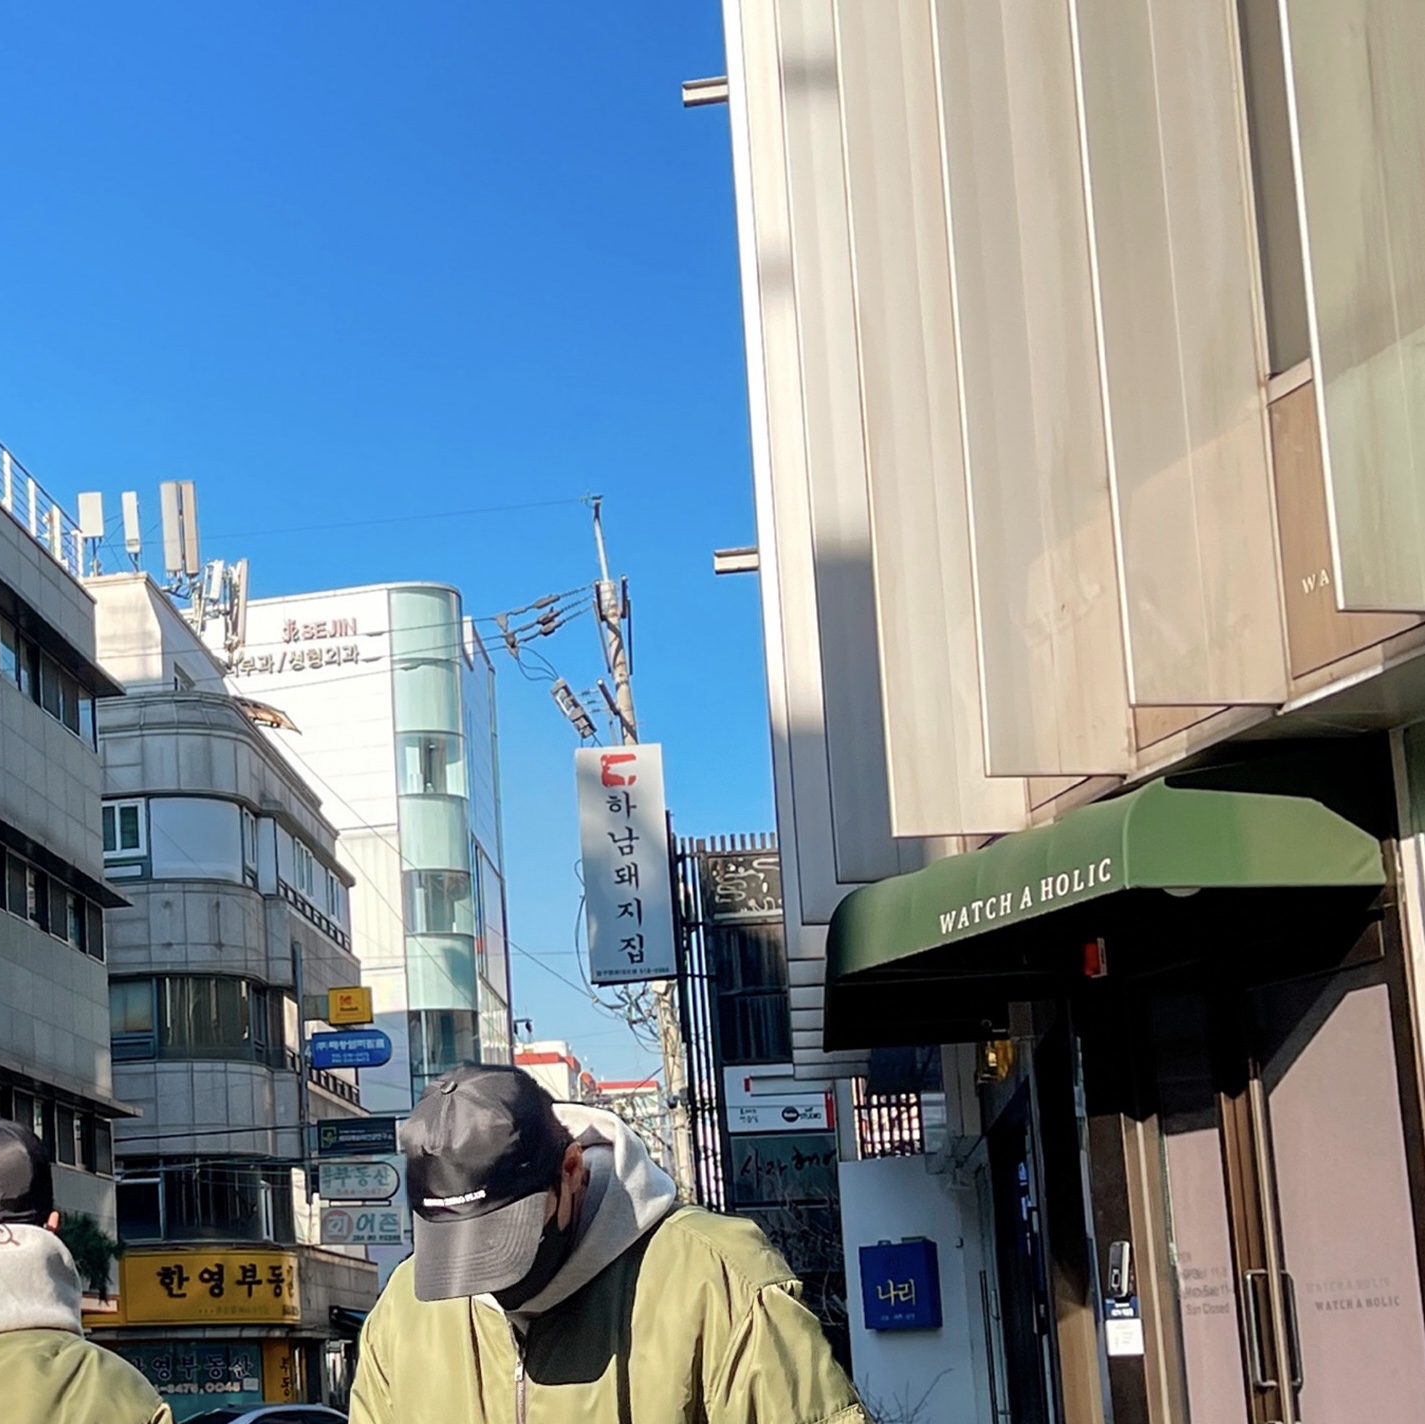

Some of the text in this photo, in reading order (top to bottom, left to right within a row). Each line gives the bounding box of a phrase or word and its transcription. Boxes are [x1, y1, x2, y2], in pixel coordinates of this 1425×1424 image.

[606, 791, 644, 964] 하남돼지집
[939, 858, 1112, 935] WATCH A HOLIC
[356, 1212, 399, 1237] 어촌
[877, 1278, 916, 1307] 나리
[1315, 1300, 1354, 1312] WATCH
[1366, 1296, 1400, 1309] HOLIC
